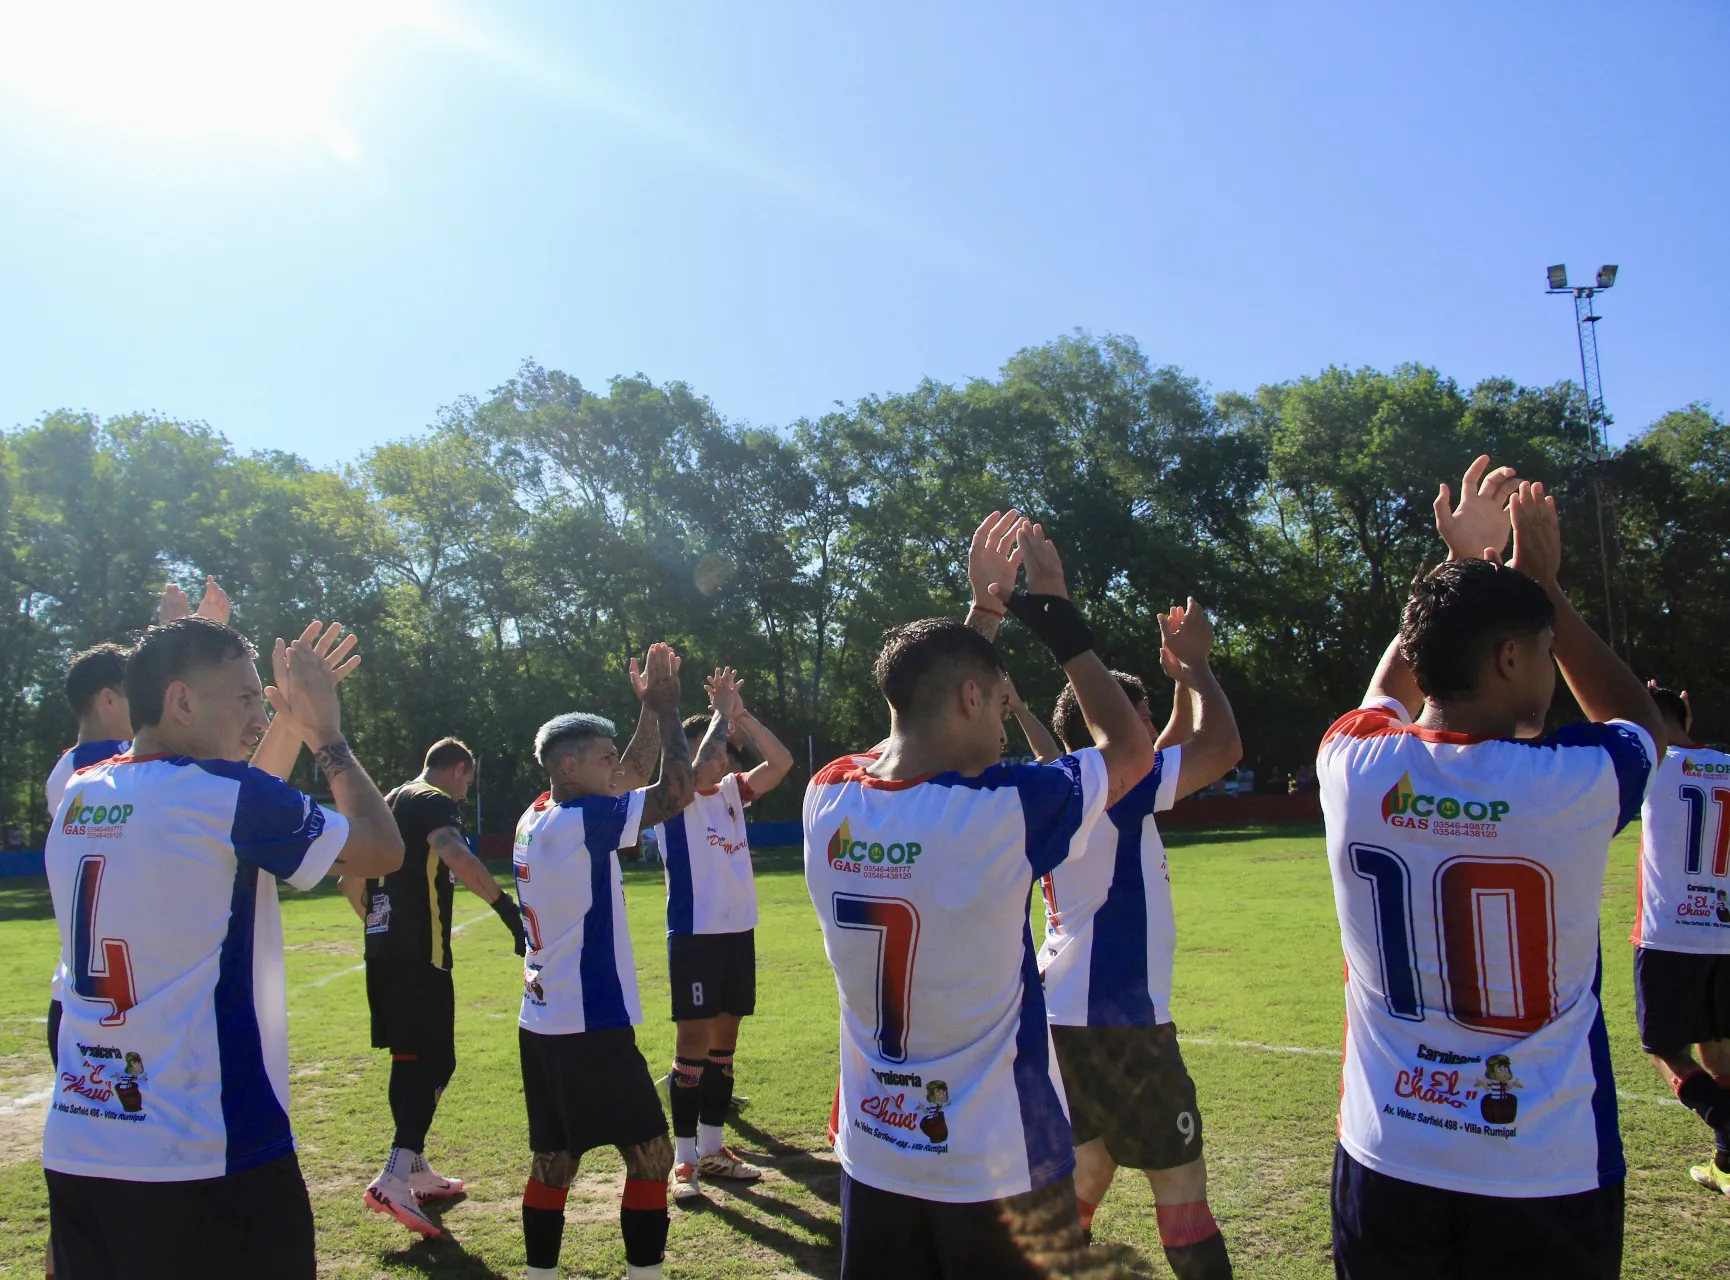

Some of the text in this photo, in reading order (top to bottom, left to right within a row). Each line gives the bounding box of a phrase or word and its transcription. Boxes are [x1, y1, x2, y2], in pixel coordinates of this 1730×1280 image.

[1390, 792, 1510, 822] UCOOP
[65, 826, 86, 835] GAS
[1391, 816, 1496, 830] GAS 03546-498777
[1433, 829, 1498, 838] 03546-438120
[1679, 784, 1730, 877] 11
[834, 837, 922, 865] UCOOP
[834, 860, 911, 873] GAS 03546-498777
[863, 872, 912, 880] 03546-438120
[71, 855, 138, 1027] 4
[1348, 842, 1559, 1039] 10
[832, 891, 921, 1064] 7
[692, 982, 704, 1006] 8
[1177, 1111, 1195, 1145] 9
[1444, 1119, 1457, 1131] 498
[1464, 1123, 1482, 1135] Villa
[1483, 1126, 1517, 1140] Rumipal
